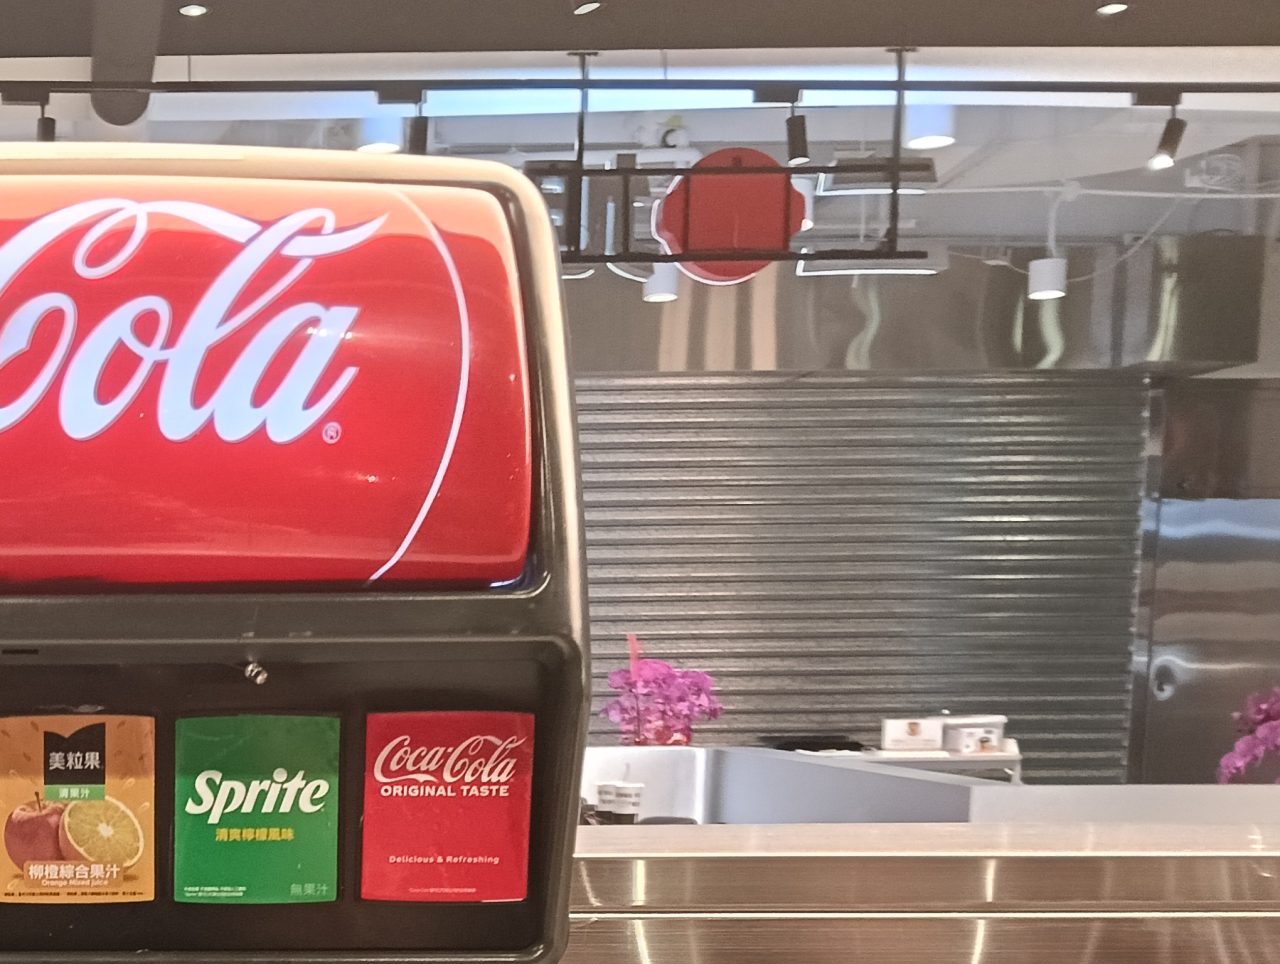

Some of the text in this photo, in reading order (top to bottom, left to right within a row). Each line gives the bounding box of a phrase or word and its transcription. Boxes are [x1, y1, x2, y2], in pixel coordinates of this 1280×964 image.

[48, 751, 101, 771] 美粒果
[373, 735, 527, 783] Coca-Cola
[184, 767, 330, 825] Sprite
[380, 785, 509, 797] ORIGINAL TASTE
[388, 855, 435, 864] Delicious
[445, 855, 500, 865] Refreshing
[28, 863, 120, 880] 柳橙綜合果汁
[41, 879, 67, 888] Orange
[290, 882, 328, 897] 無果汁
